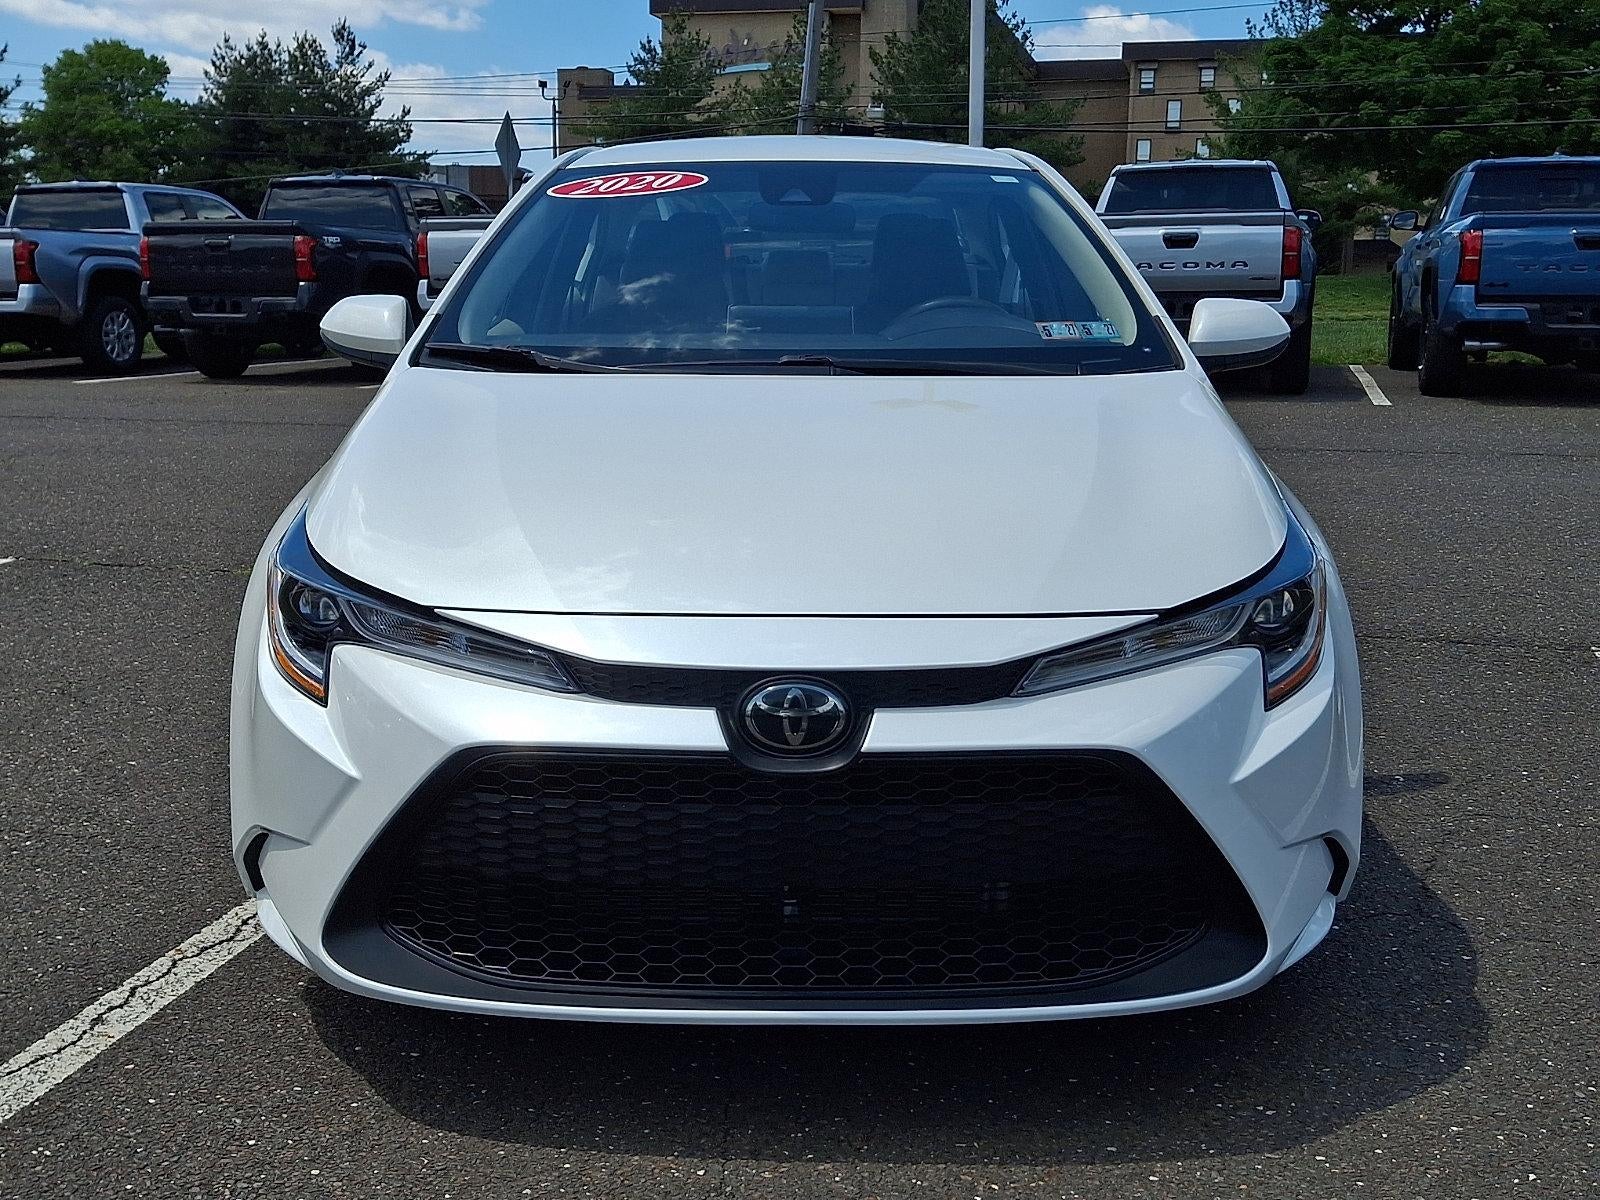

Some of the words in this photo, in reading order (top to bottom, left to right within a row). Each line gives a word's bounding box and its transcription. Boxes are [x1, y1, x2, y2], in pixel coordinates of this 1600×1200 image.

[568, 174, 683, 195] 2020
[322, 236, 341, 244] TRD
[1136, 260, 1249, 271] ACOMA
[1516, 264, 1600, 273] TAC
[1042, 325, 1053, 338] 5
[1081, 323, 1093, 336] 5
